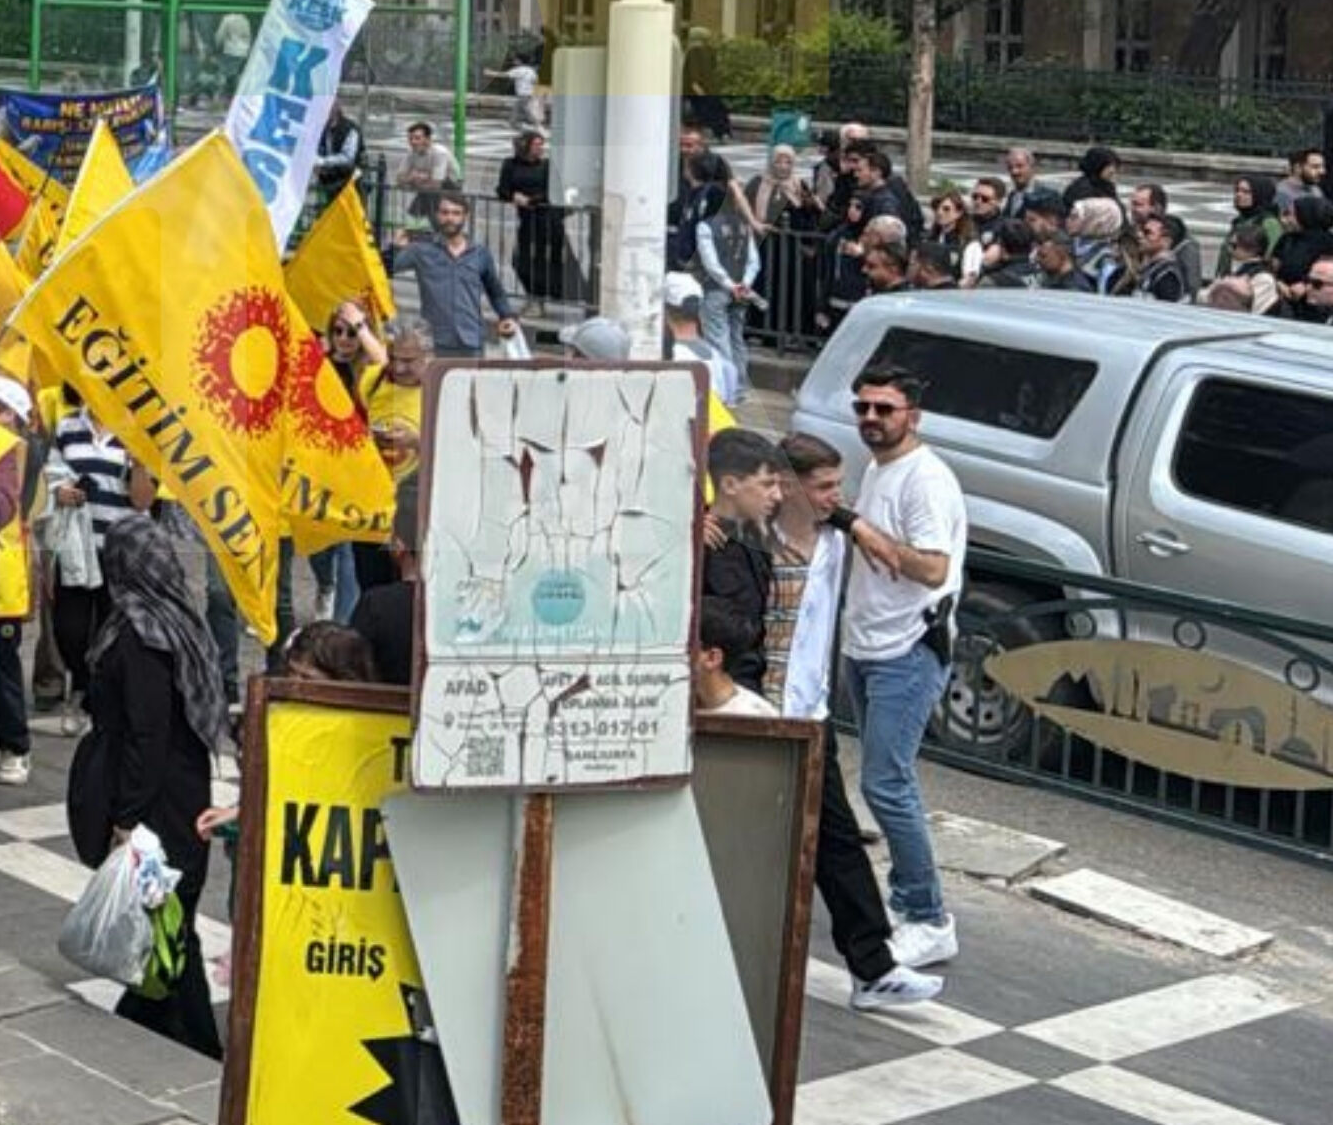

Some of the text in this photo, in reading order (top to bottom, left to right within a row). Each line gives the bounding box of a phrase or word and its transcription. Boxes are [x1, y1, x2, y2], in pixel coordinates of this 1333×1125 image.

[54, 295, 214, 486] EĞİTİM
[201, 483, 270, 591] SEN
[445, 679, 489, 695] AFAD
[305, 935, 388, 982] GİRİŞ
